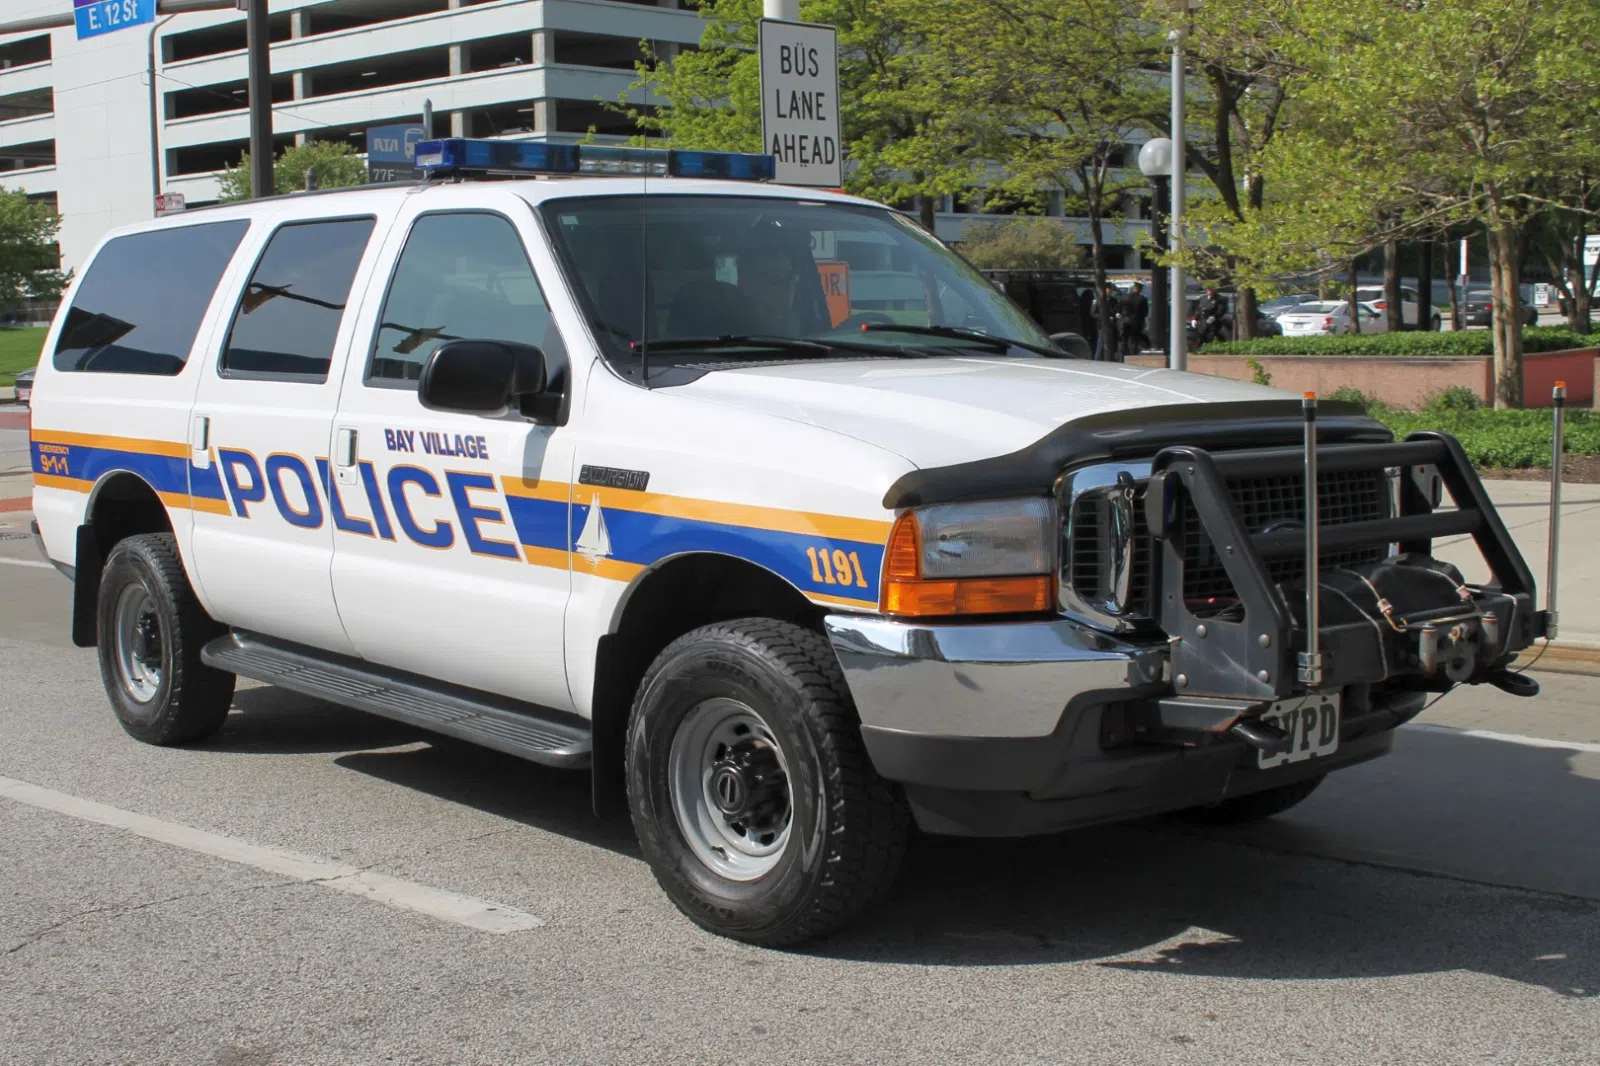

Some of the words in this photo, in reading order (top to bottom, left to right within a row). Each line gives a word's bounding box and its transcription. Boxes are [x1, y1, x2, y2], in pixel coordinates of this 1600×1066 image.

[88, 7, 102, 30] E.
[105, 2, 121, 26] 12
[122, 0, 138, 22] St
[780, 44, 819, 77] BUS
[776, 88, 826, 121] LANE
[373, 138, 399, 152] RTA
[772, 133, 835, 165] AHEAD
[372, 169, 396, 181] 77F
[384, 428, 414, 452] BAY
[419, 431, 489, 460] VILLAGE
[580, 465, 648, 490] EXCURSION
[217, 446, 523, 562] POLICE
[806, 547, 868, 589] 1191
